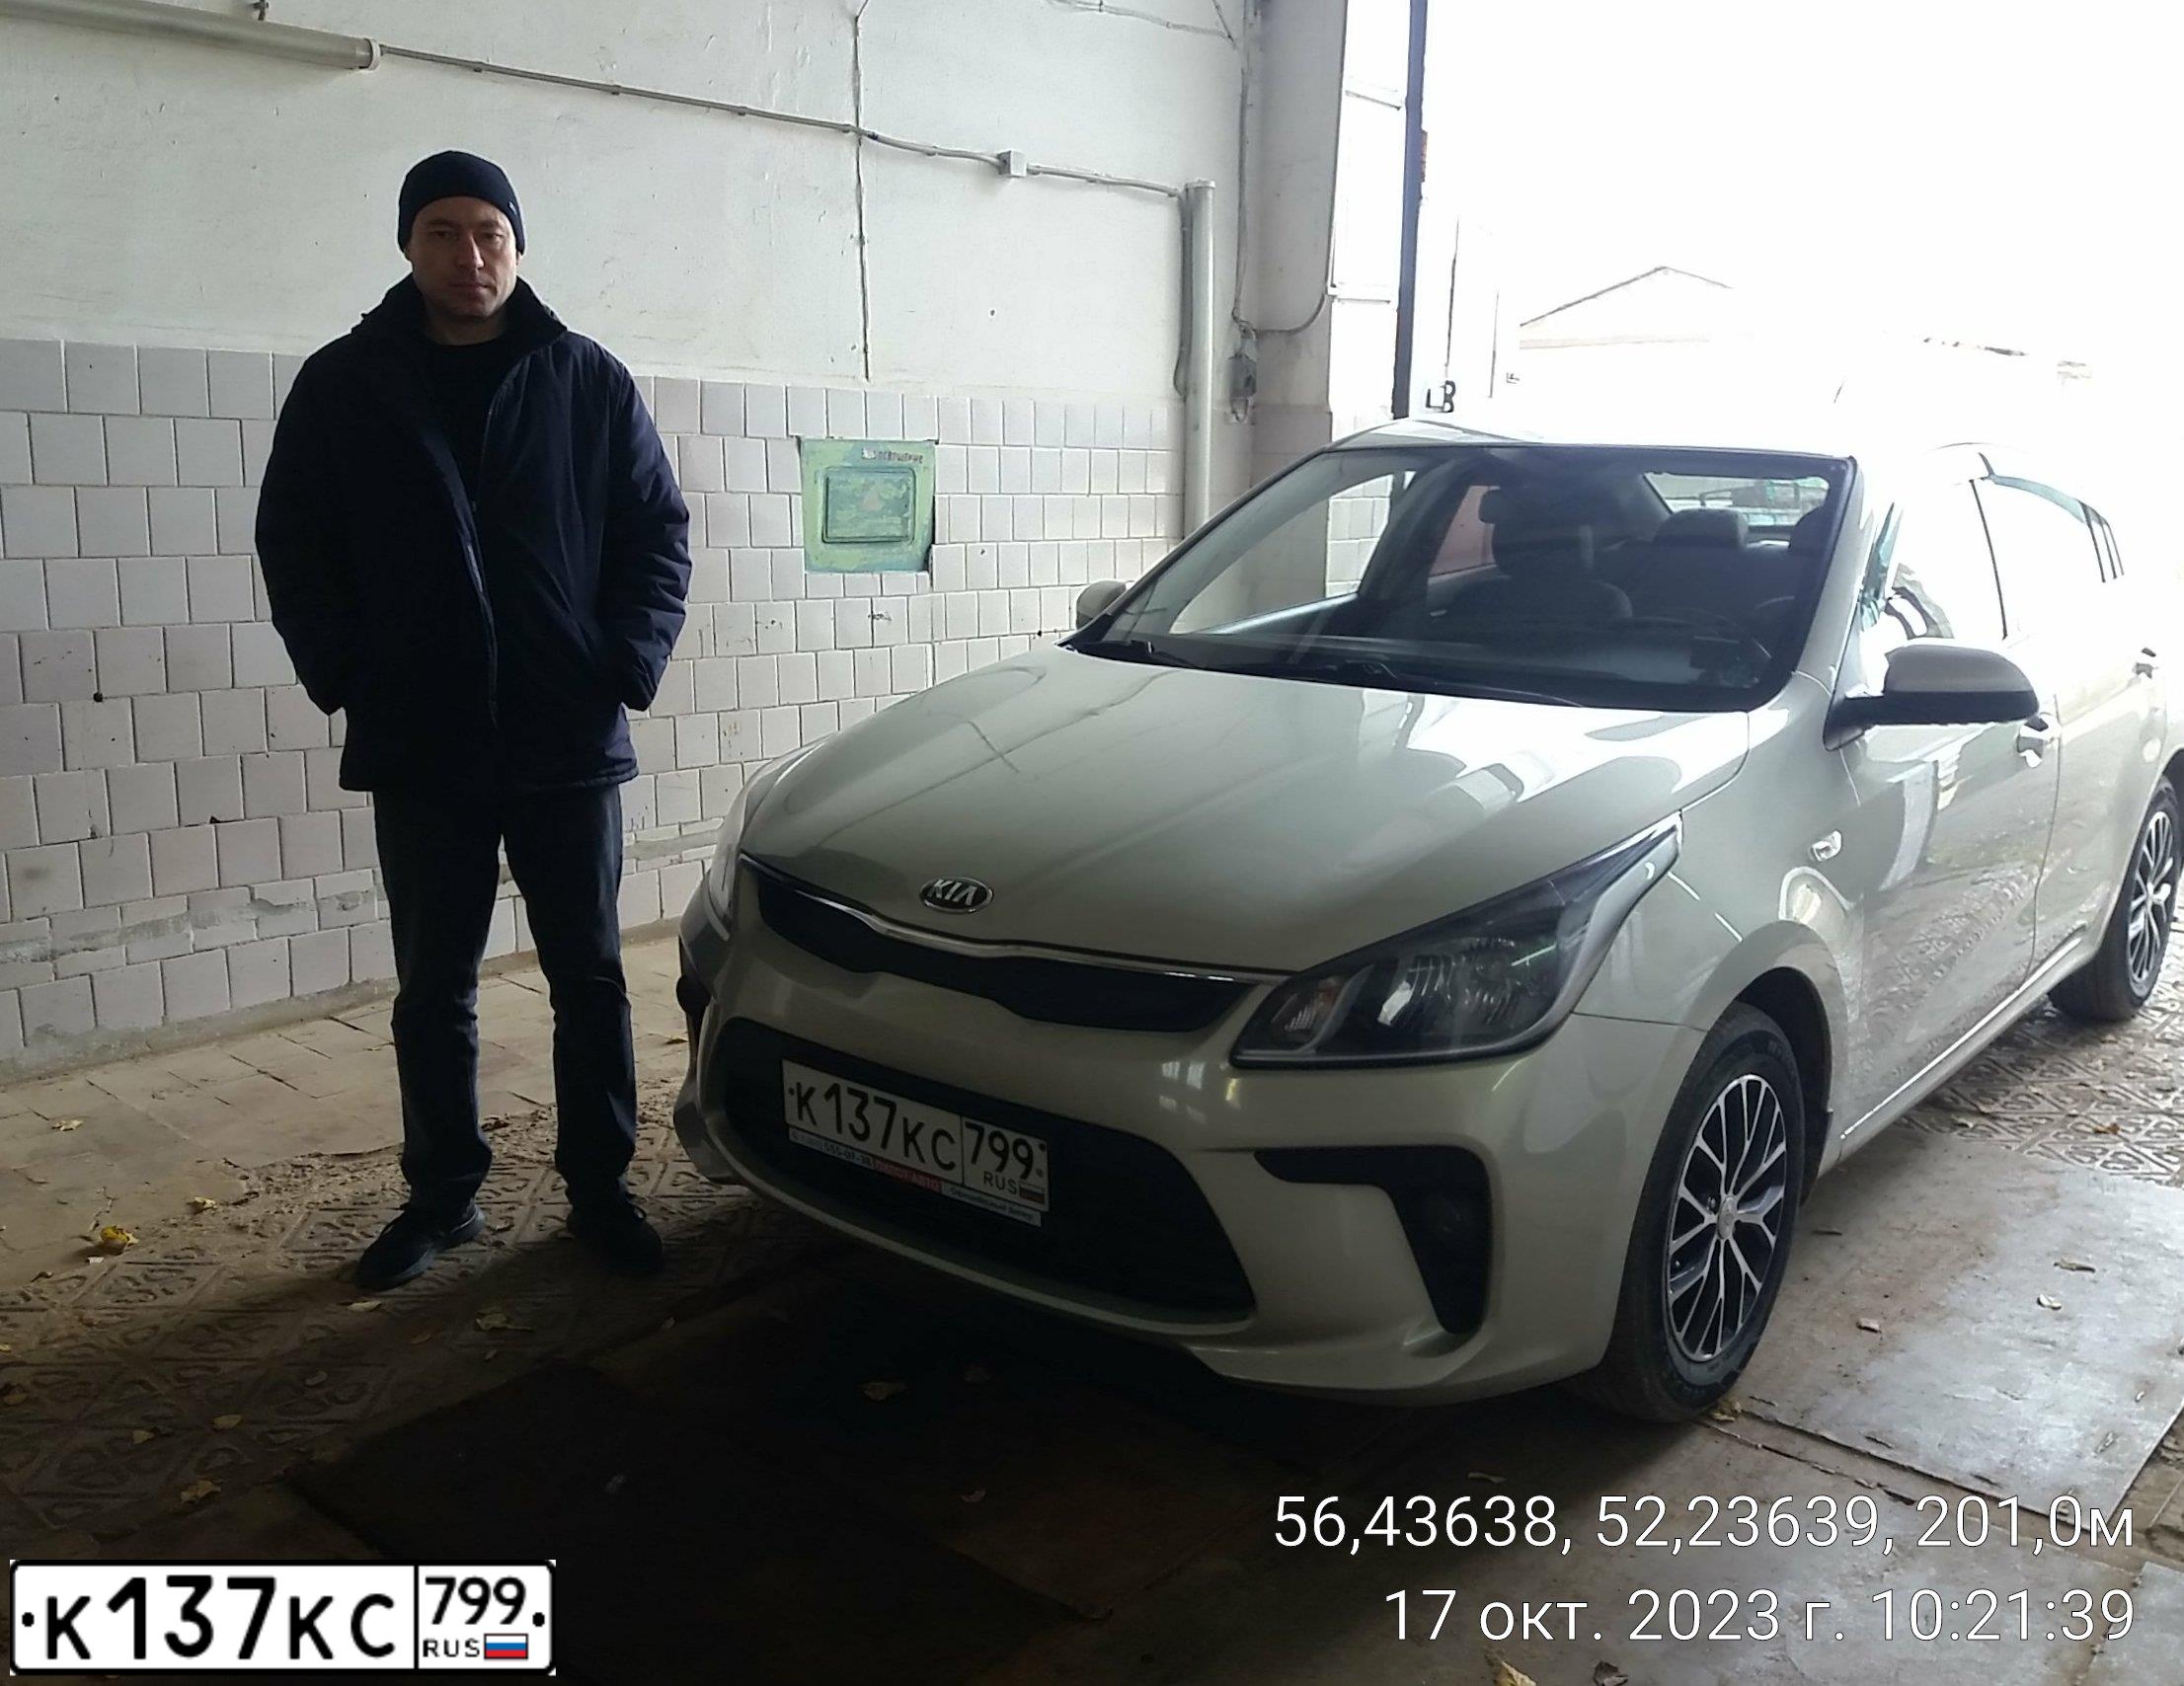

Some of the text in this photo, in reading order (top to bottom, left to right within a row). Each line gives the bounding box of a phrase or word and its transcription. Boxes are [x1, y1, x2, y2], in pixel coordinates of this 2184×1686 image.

[928, 879, 977, 905] KIA
[796, 1082, 956, 1171] К137КС
[964, 1121, 1035, 1180] 799
[982, 1171, 1017, 1195] RUS
